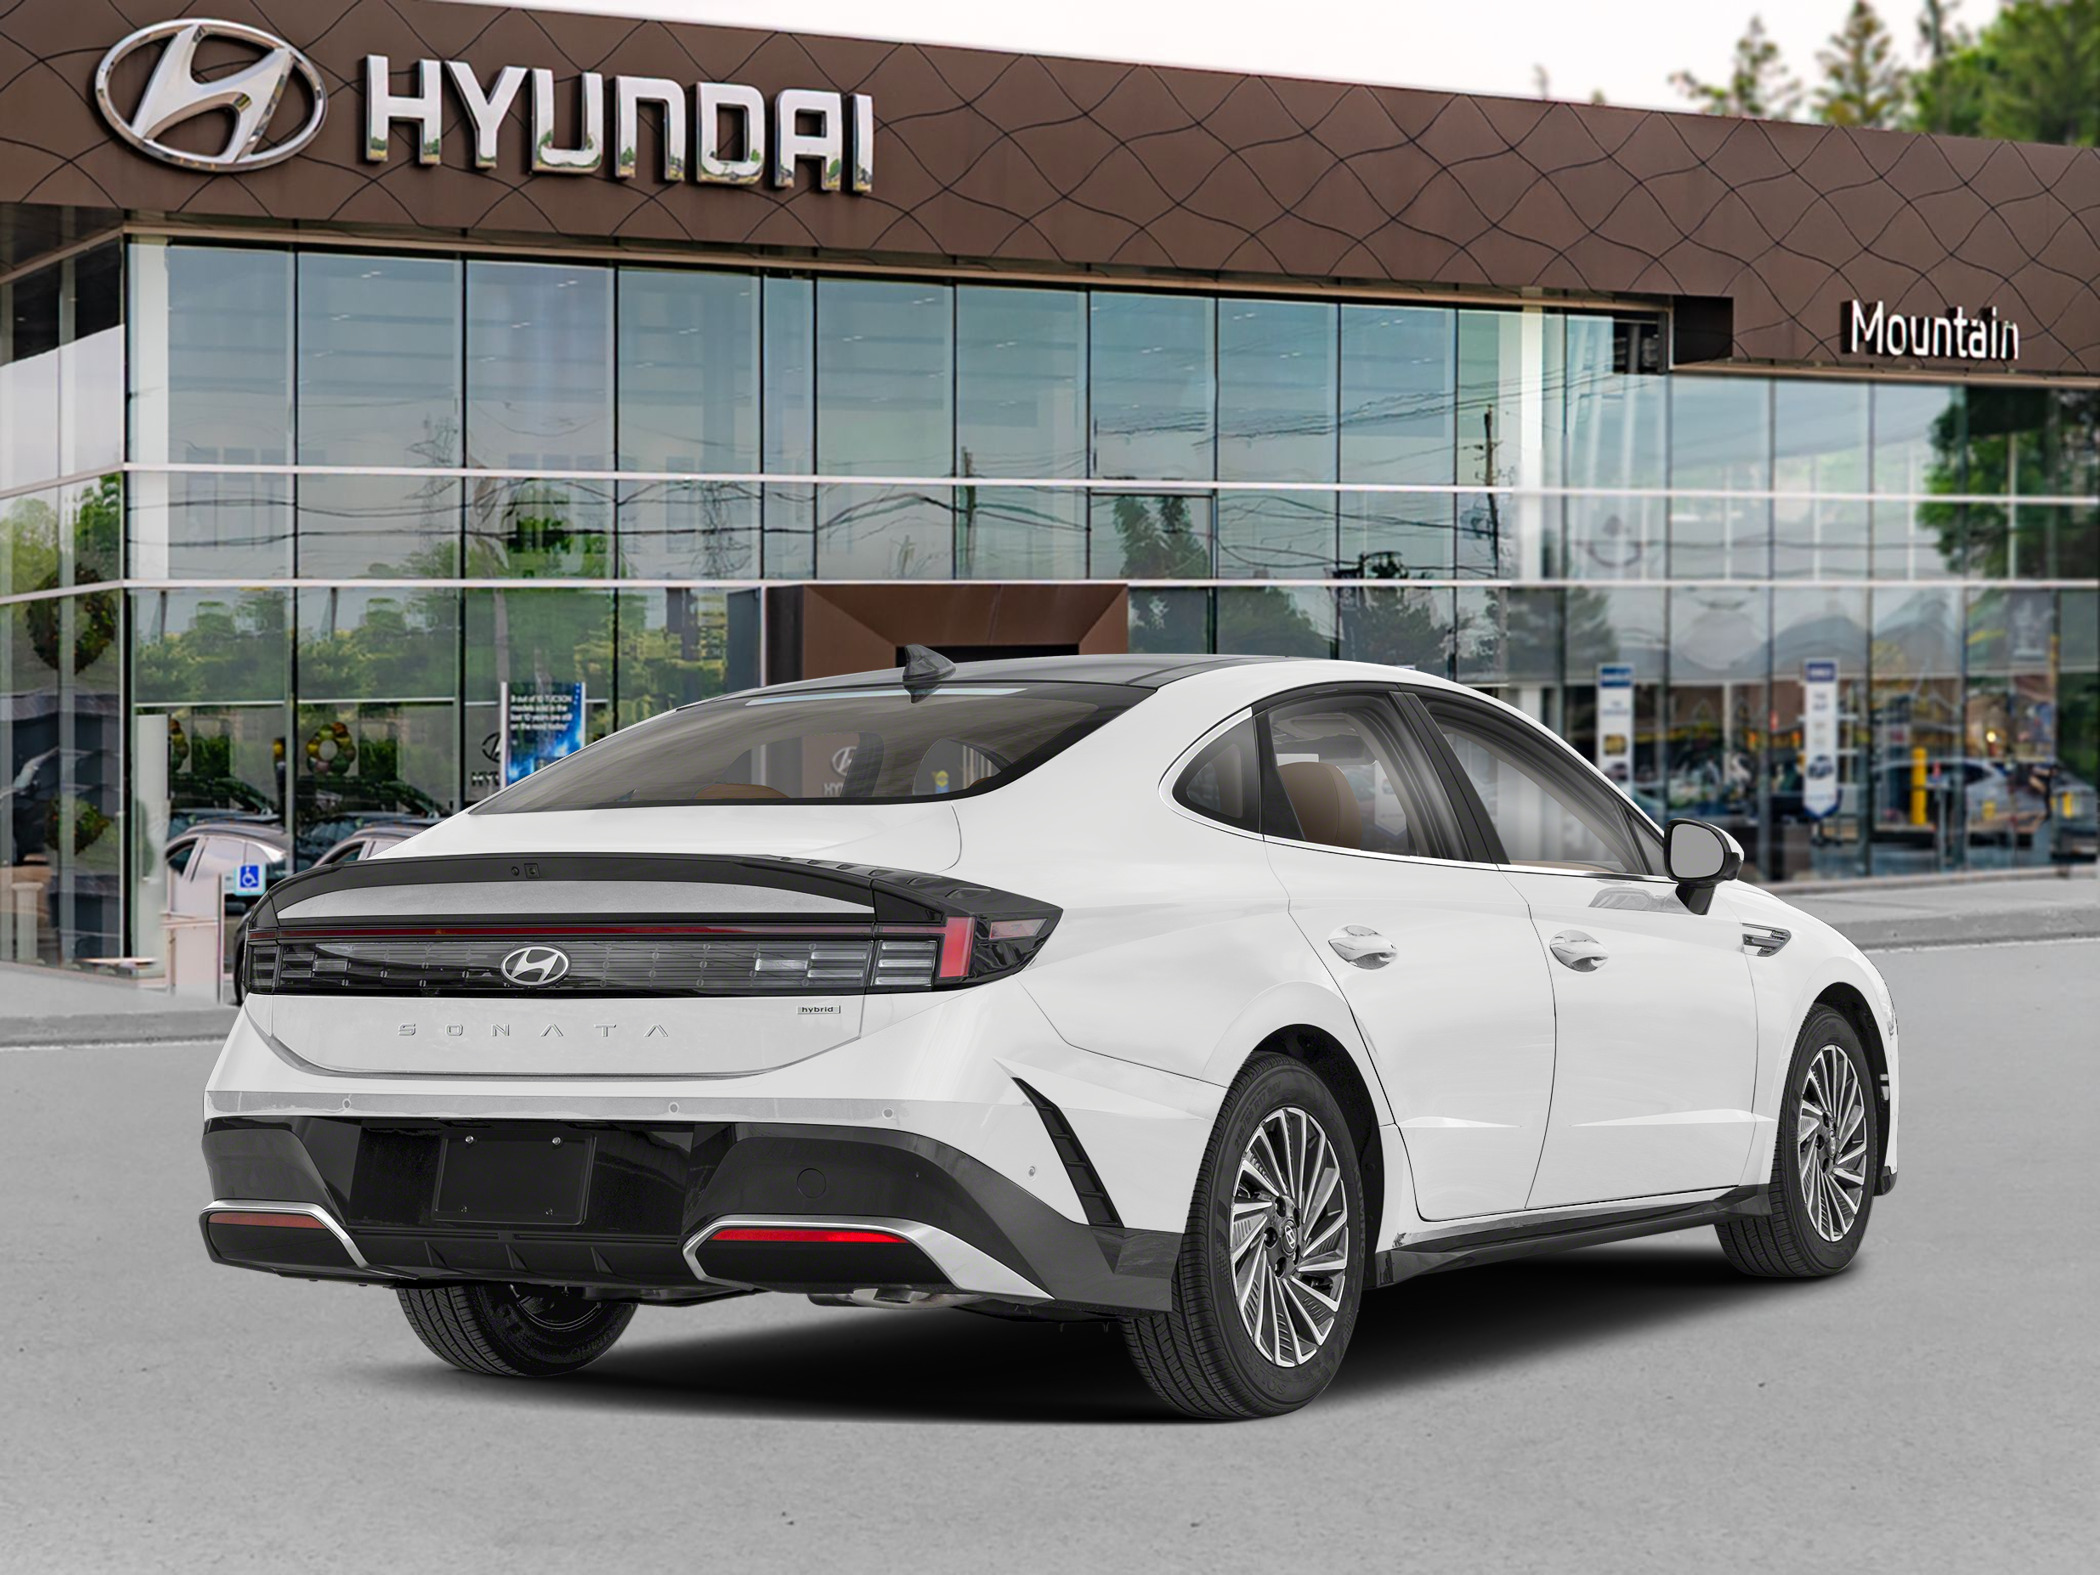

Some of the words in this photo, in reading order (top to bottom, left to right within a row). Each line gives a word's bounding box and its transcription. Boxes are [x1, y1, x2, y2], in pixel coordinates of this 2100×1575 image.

[366, 54, 874, 193] HYUNDAI
[1850, 299, 2019, 360] Mountain
[801, 1006, 834, 1014] hybrid
[397, 1023, 669, 1037] SONATA
